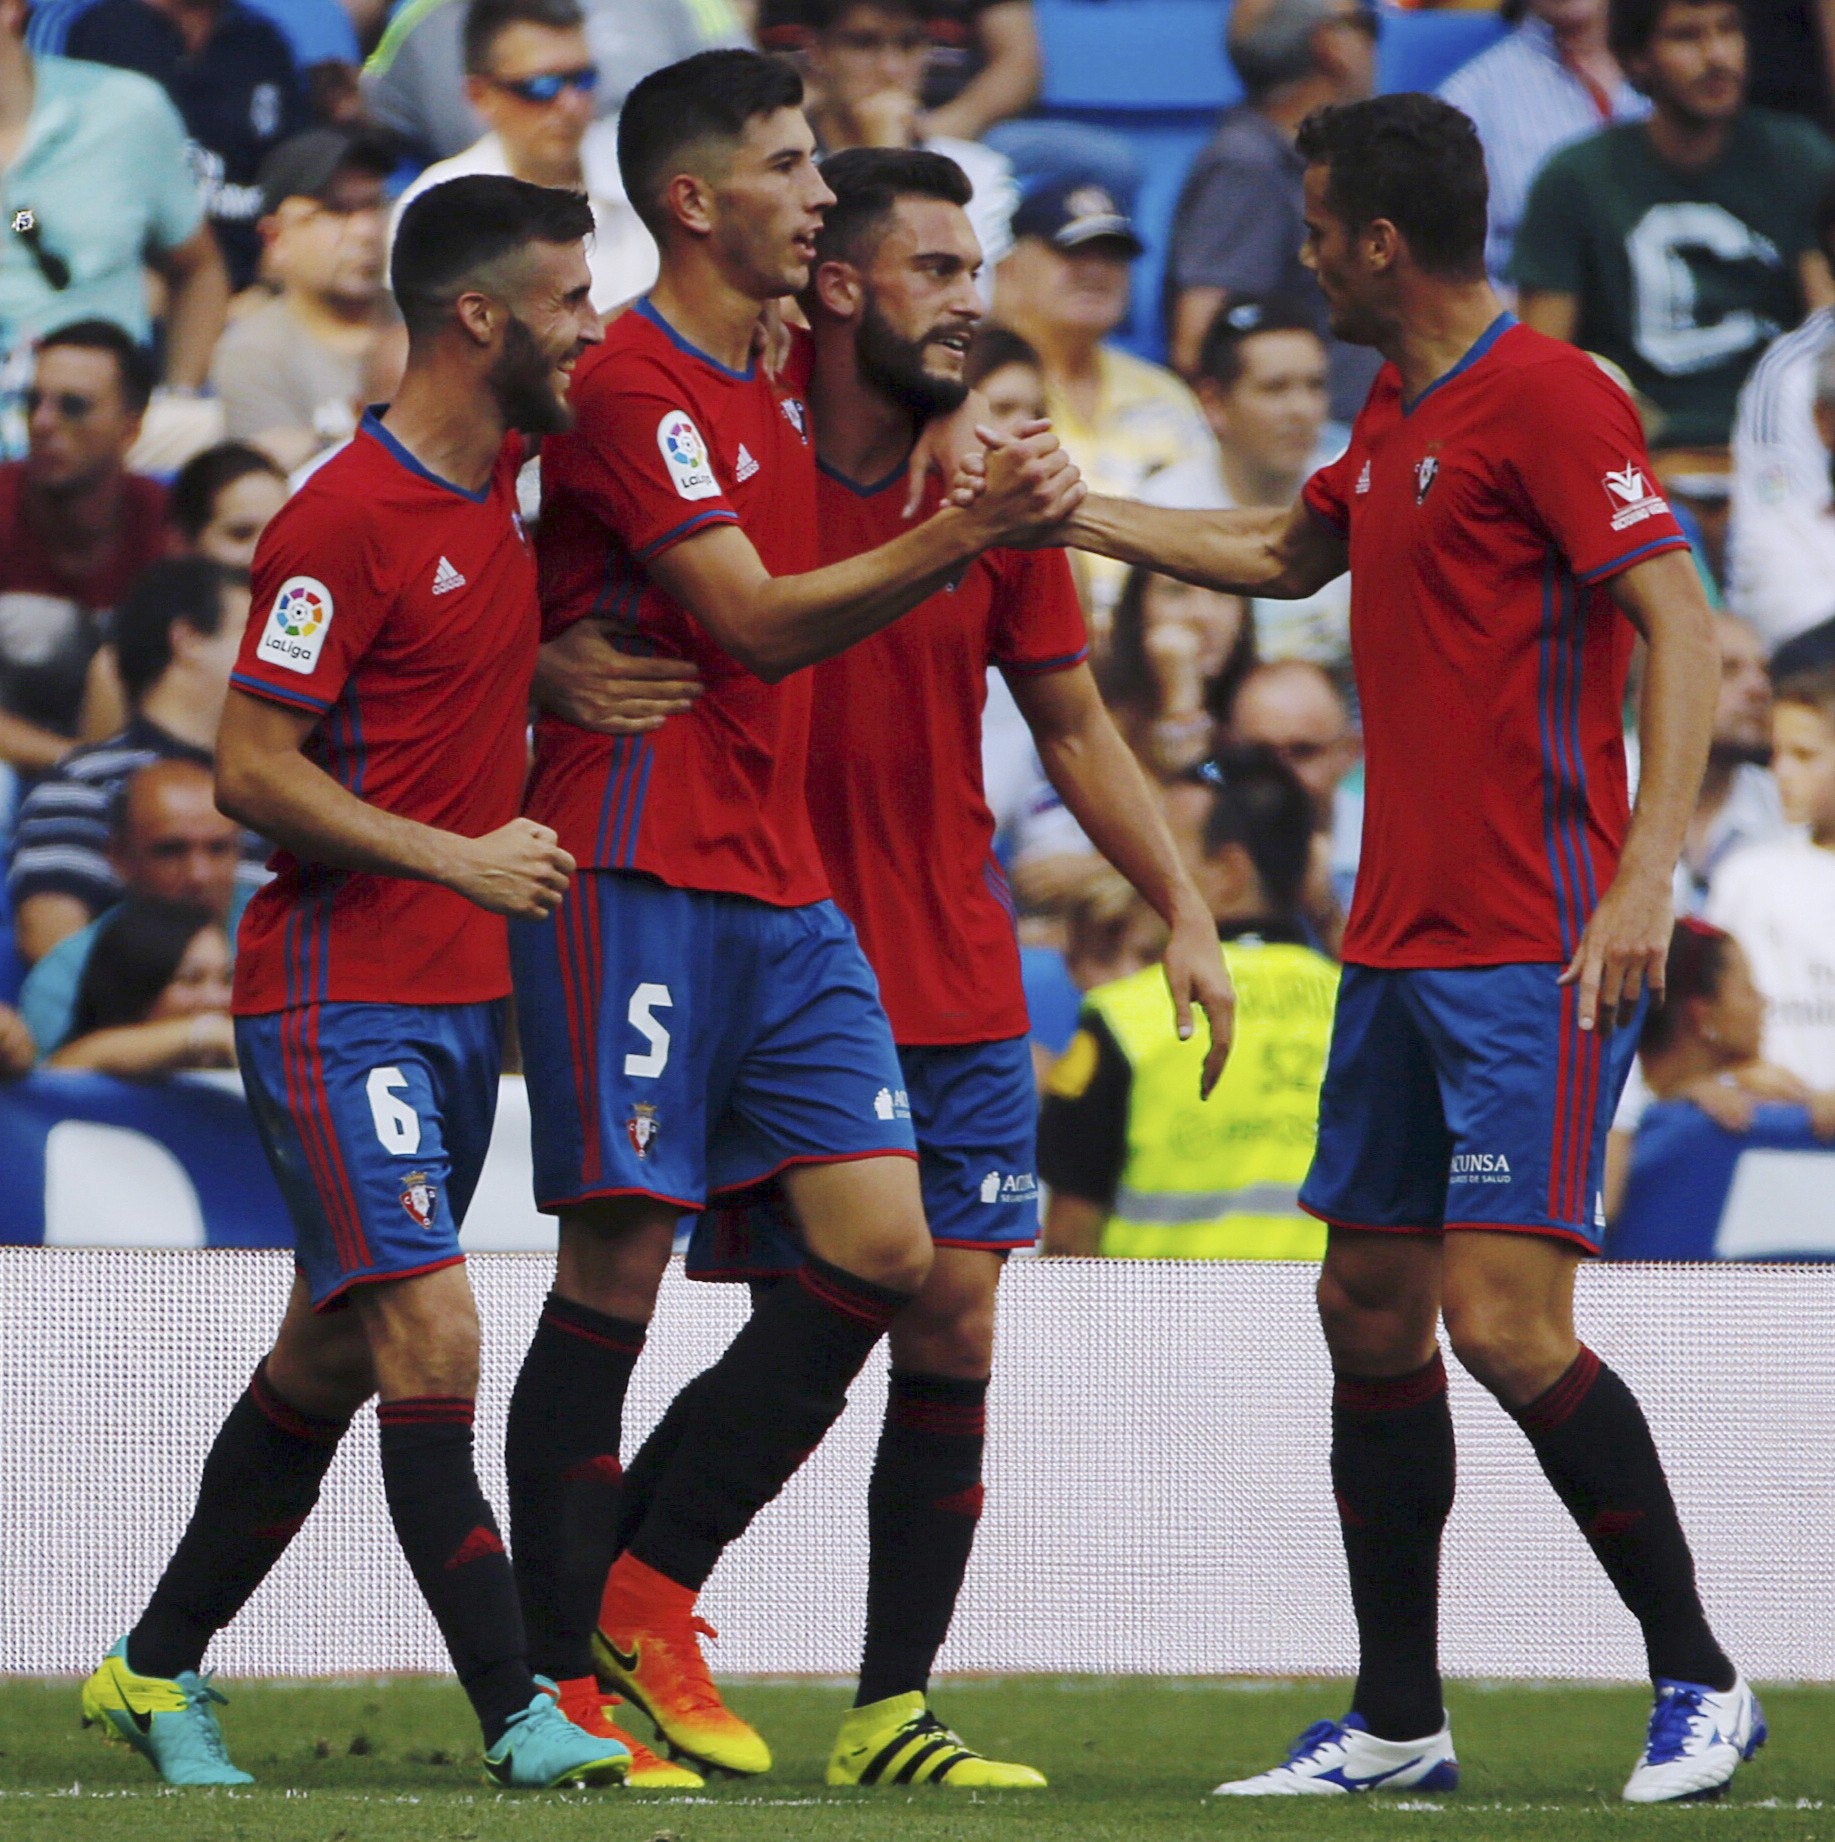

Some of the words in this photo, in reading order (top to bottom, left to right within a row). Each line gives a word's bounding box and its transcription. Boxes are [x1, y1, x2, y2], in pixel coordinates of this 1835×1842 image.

[1625, 202, 1782, 376] C
[265, 635, 311, 660] LaLiga
[624, 982, 673, 1078] 5
[365, 1066, 421, 1156] 6
